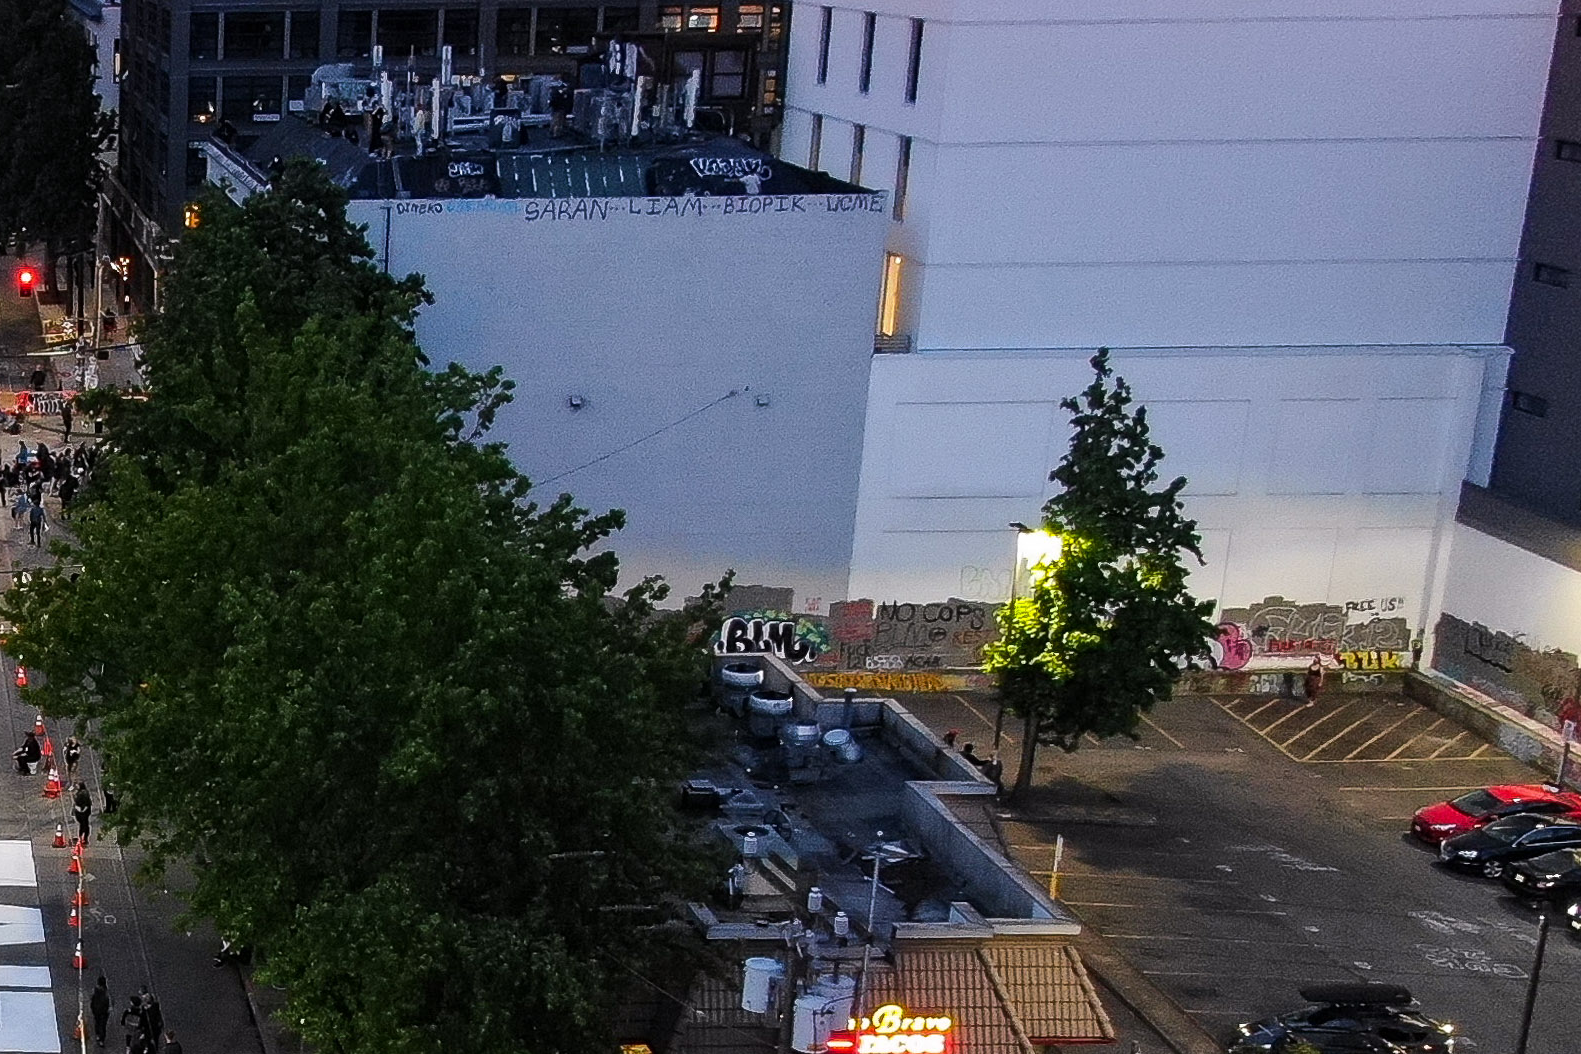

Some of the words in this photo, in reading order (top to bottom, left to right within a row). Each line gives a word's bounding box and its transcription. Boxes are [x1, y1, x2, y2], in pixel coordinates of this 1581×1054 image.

[628, 196, 703, 216] LIAM
[723, 195, 807, 214] BIOPIK
[880, 600, 917, 622] NO
[923, 603, 985, 630] COPS
[720, 616, 814, 664] BLM
